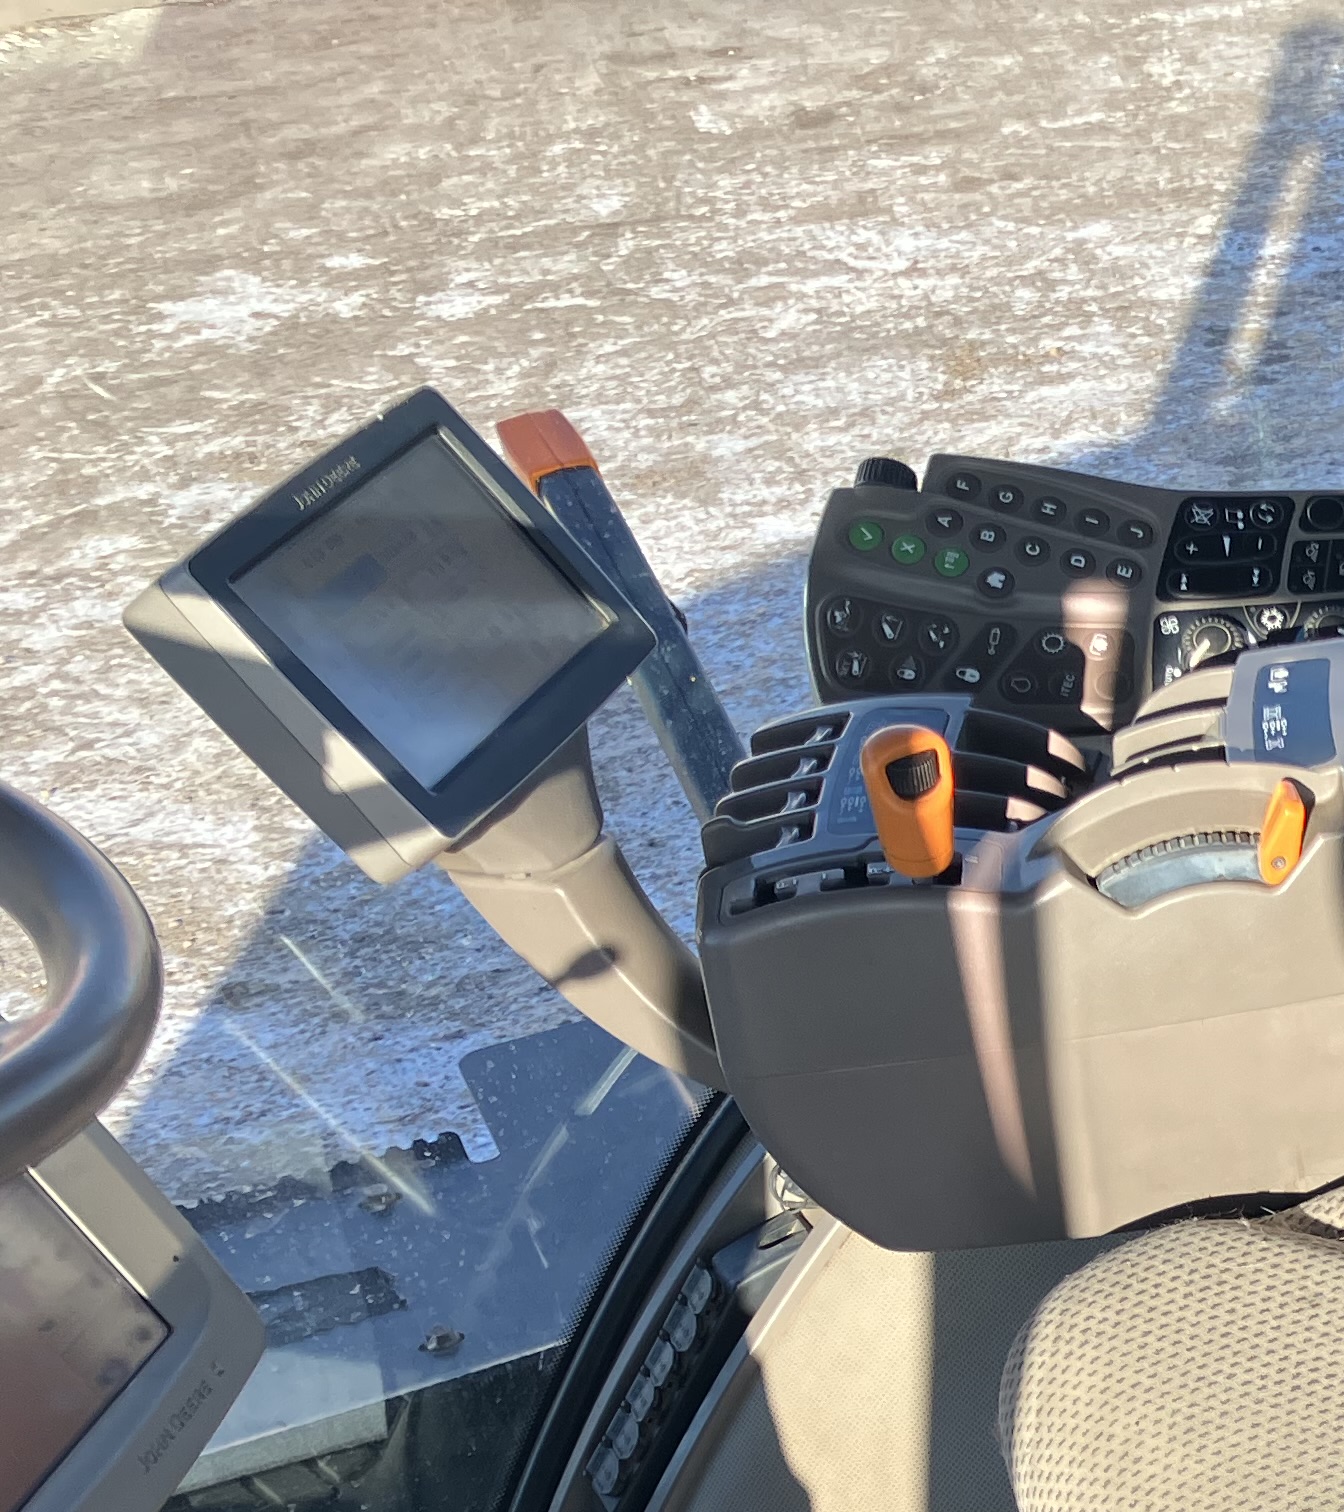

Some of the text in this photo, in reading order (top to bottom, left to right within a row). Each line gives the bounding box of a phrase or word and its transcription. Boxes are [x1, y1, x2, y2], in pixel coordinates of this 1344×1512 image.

[956, 479, 970, 491] F
[999, 491, 1013, 503] G
[1041, 502, 1057, 515] H
[937, 516, 952, 528] A
[980, 530, 995, 542] B
[1130, 527, 1144, 538] J
[1025, 543, 1040, 556] C
[1070, 555, 1086, 568] D
[1116, 565, 1133, 578] E
[138, 1380, 213, 1474] JOHN DEERE
